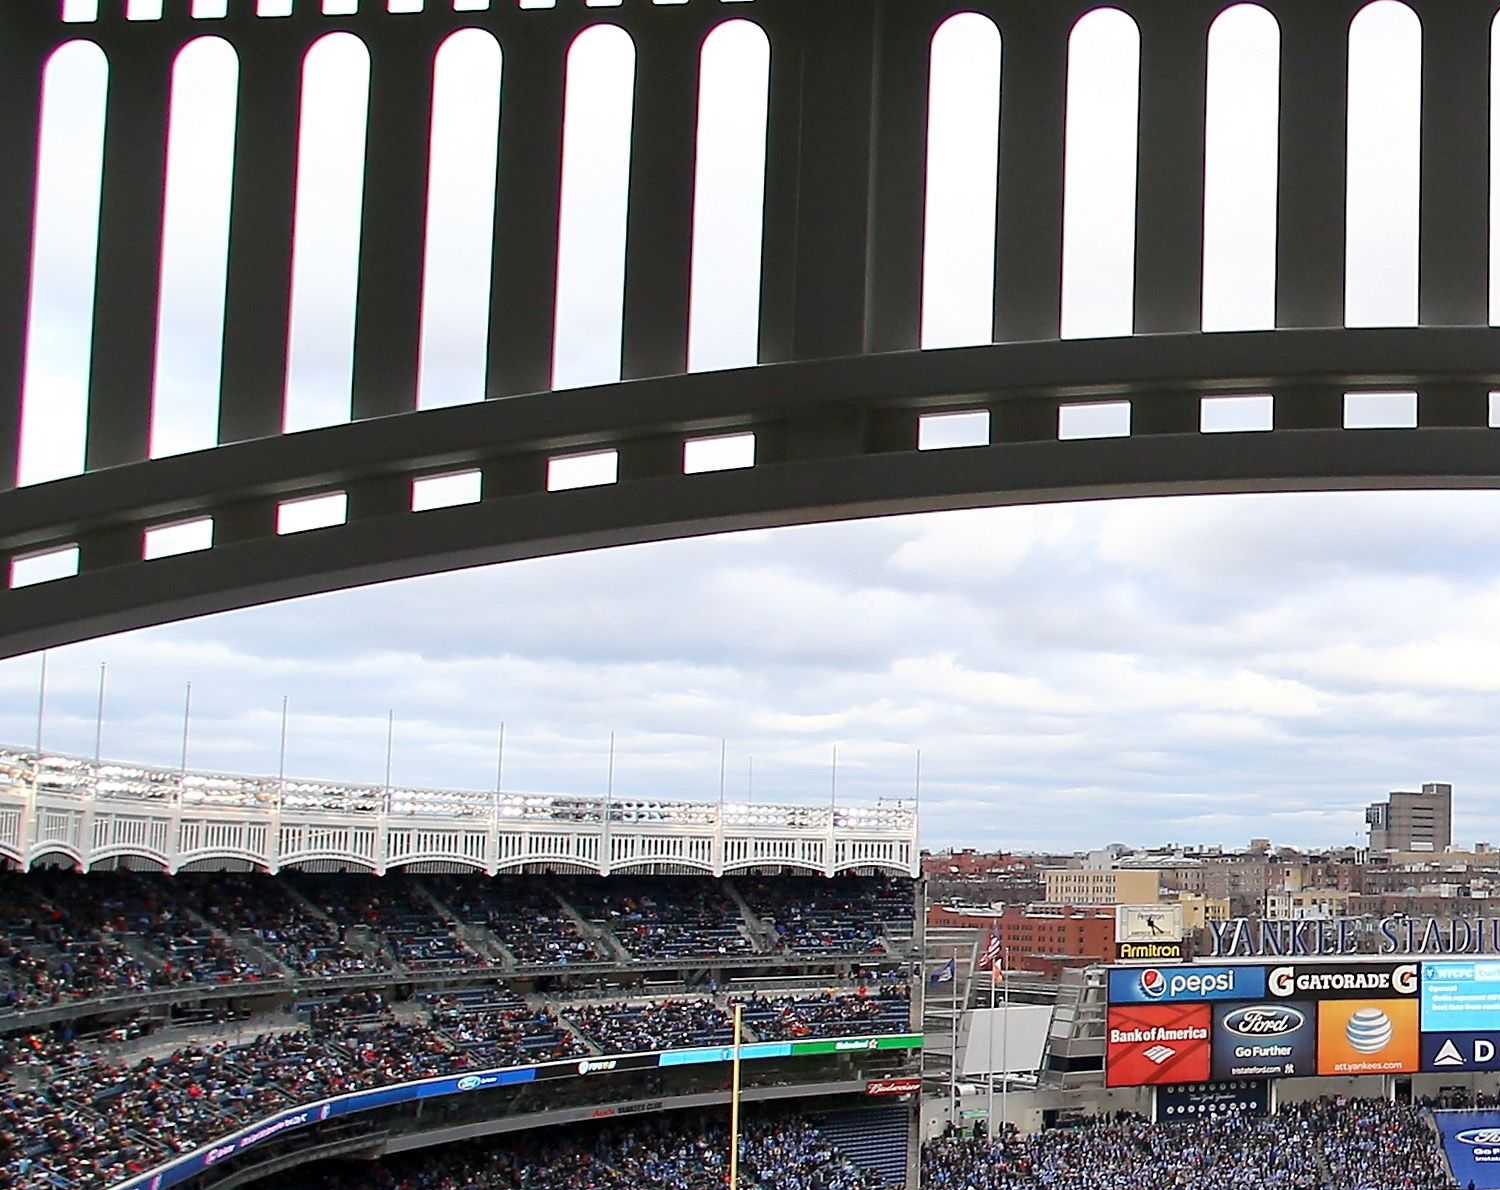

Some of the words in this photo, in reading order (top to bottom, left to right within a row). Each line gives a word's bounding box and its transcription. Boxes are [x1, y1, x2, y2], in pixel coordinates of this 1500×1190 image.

[1207, 916, 1357, 957] YANKEE
[1121, 943, 1180, 958] Armitron
[1170, 969, 1235, 997] pepsi
[1297, 973, 1390, 990] GATORADE
[1239, 1009, 1288, 1034] Ford
[1110, 1027, 1143, 1043] Bank
[1156, 1025, 1207, 1041] America
[1235, 1046, 1252, 1058] Go
[1252, 1045, 1292, 1057] Further
[1334, 1061, 1403, 1072] att.yankees.com
[868, 1081, 922, 1096] Budweiser
